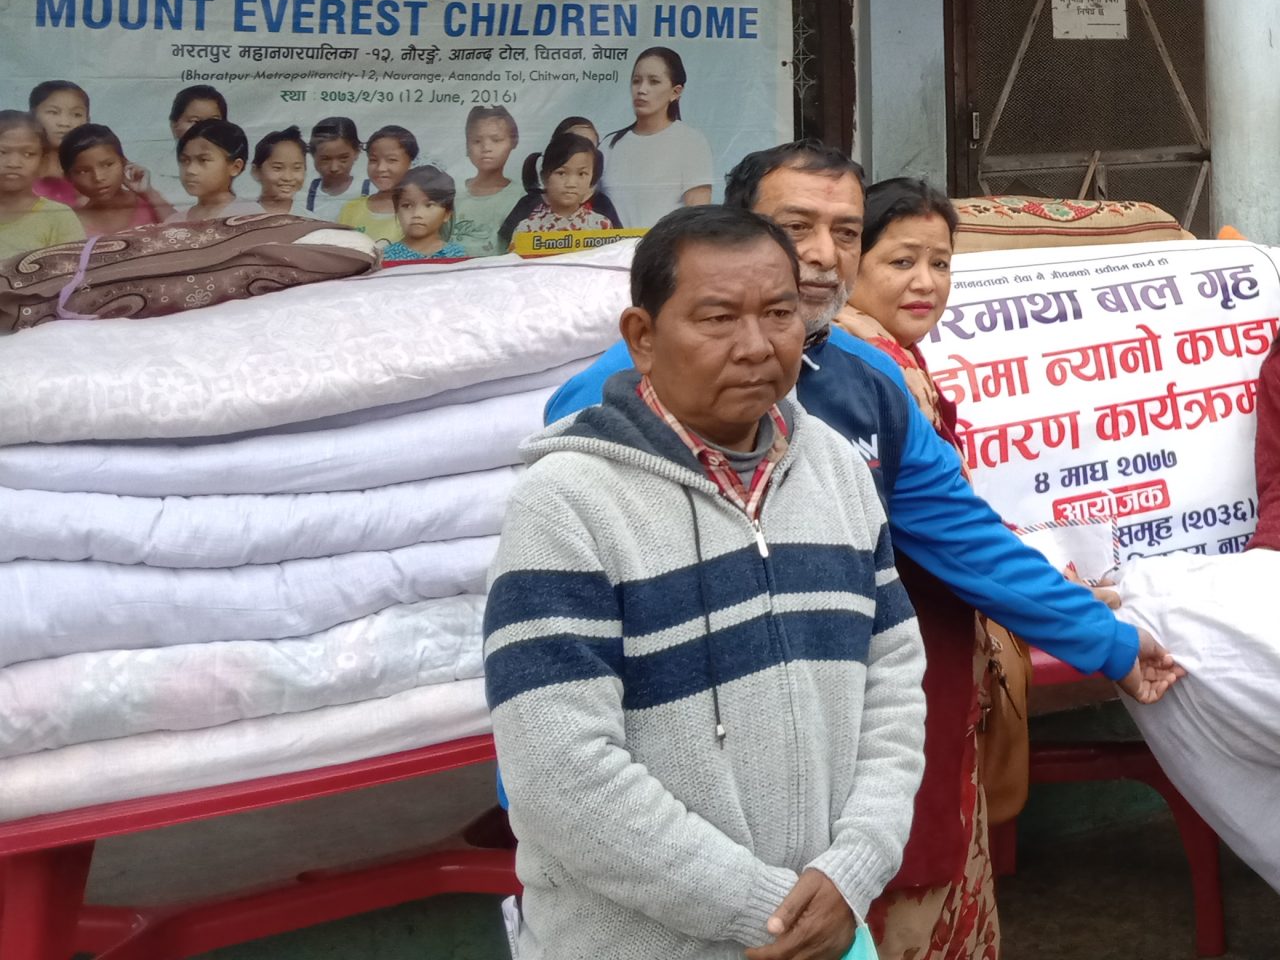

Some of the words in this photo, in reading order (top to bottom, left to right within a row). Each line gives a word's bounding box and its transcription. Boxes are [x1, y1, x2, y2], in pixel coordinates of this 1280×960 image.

[443, 1, 637, 38] CHILDREN
[652, 4, 759, 39] HOME
[171, 44, 232, 63] भरतपुर
[238, 43, 359, 62] महानगरपालिका
[448, 47, 494, 62] आनन्द
[591, 44, 629, 61] नेपाल
[382, 70, 445, 84] Naurange,
[448, 70, 501, 82] Aananda
[504, 70, 526, 83] Tol,
[529, 70, 579, 83] Chitwan,
[582, 70, 619, 83] Nepal)
[320, 89, 394, 104] २०७३/२/३०
[399, 89, 424, 103] (12
[428, 89, 465, 106] June,
[471, 89, 518, 104] 2016)
[532, 233, 573, 250] E-mail
[1091, 274, 1183, 314] बाल
[1190, 264, 1260, 310] गृह
[1042, 323, 1163, 387] न्यानो
[1174, 317, 1280, 366] कपडा
[1060, 460, 1109, 488] माघ
[1117, 448, 1178, 477] २०७७
[1056, 484, 1164, 521] आयोजक
[1117, 515, 1173, 548] समूह
